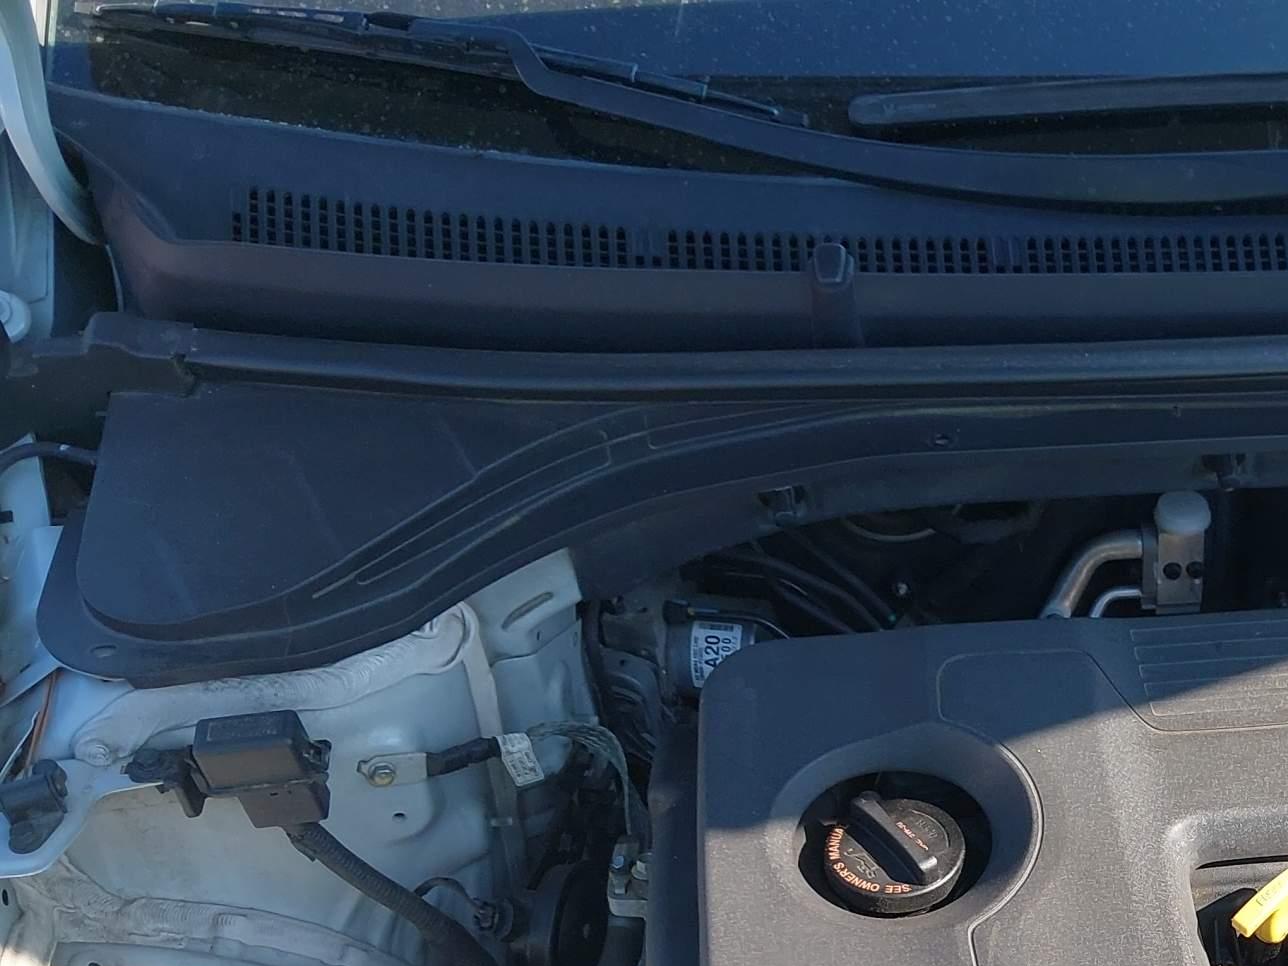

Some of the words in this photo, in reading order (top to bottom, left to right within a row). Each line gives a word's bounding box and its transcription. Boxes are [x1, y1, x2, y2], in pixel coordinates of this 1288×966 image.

[827, 826, 845, 860] MANUA
[833, 862, 880, 892] OWNER'S
[884, 883, 913, 894] SEE
